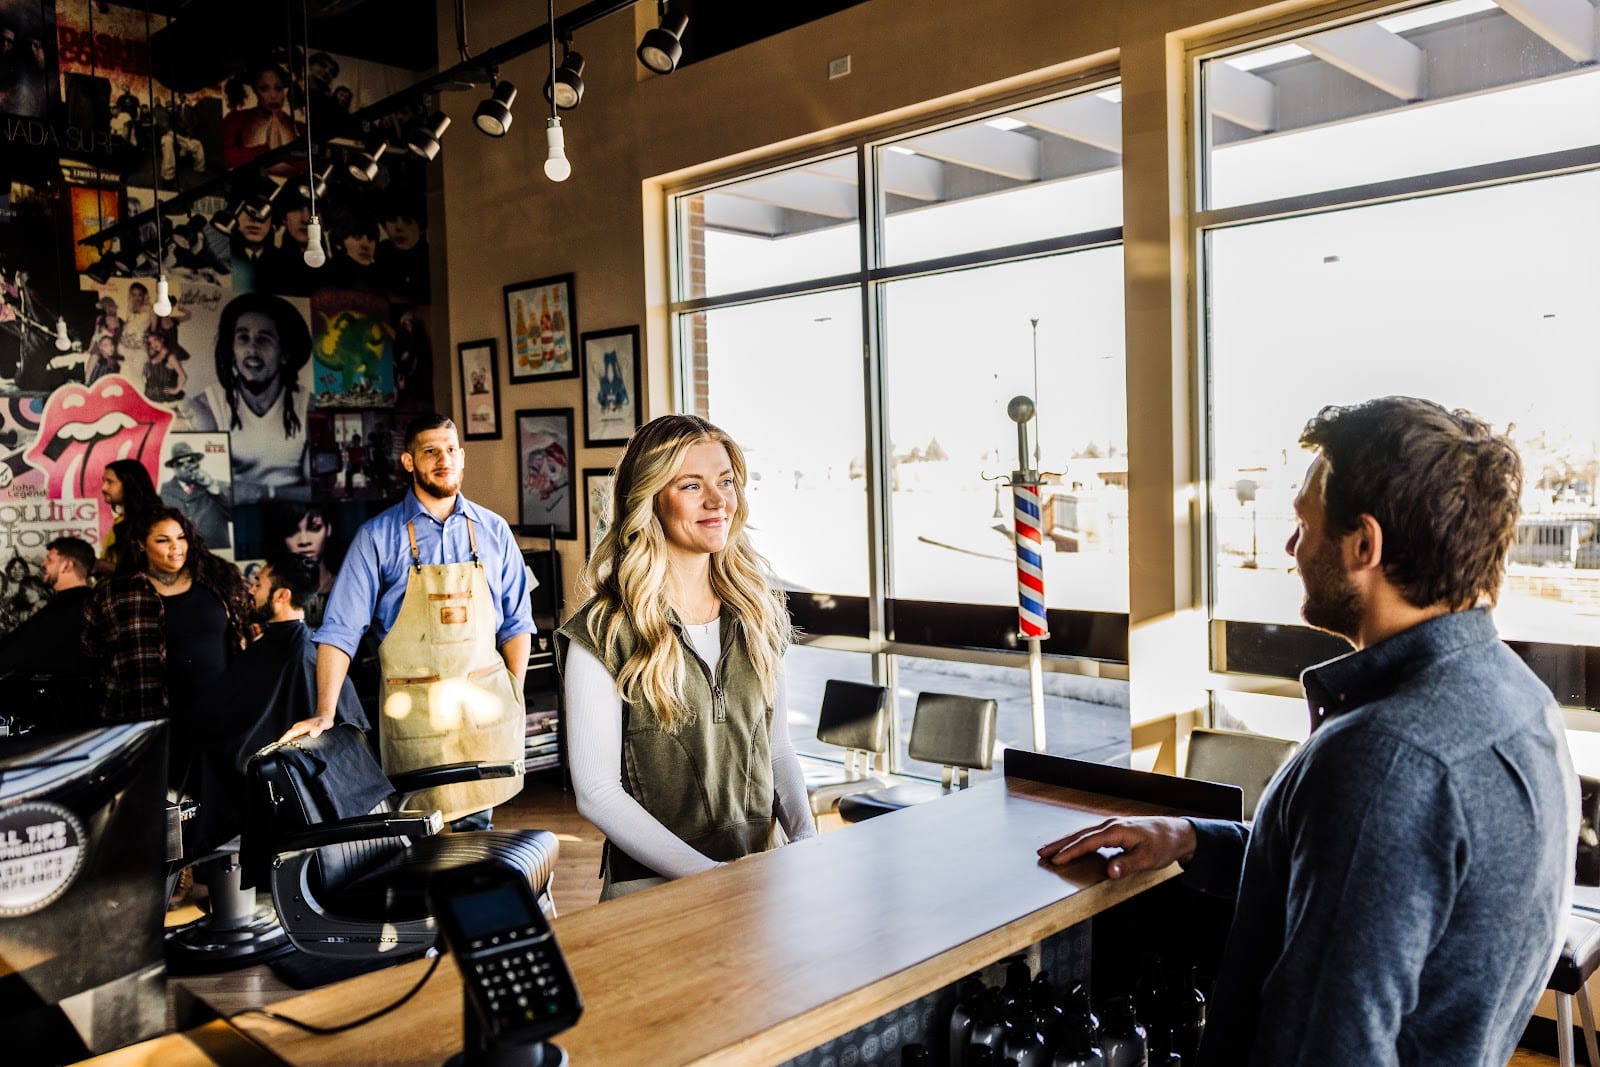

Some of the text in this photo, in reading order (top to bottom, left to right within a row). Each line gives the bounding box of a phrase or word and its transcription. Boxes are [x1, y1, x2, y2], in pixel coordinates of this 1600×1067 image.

[12, 483, 35, 492] John
[7, 488, 47, 499] Legend
[26, 821, 66, 842] TIPS
